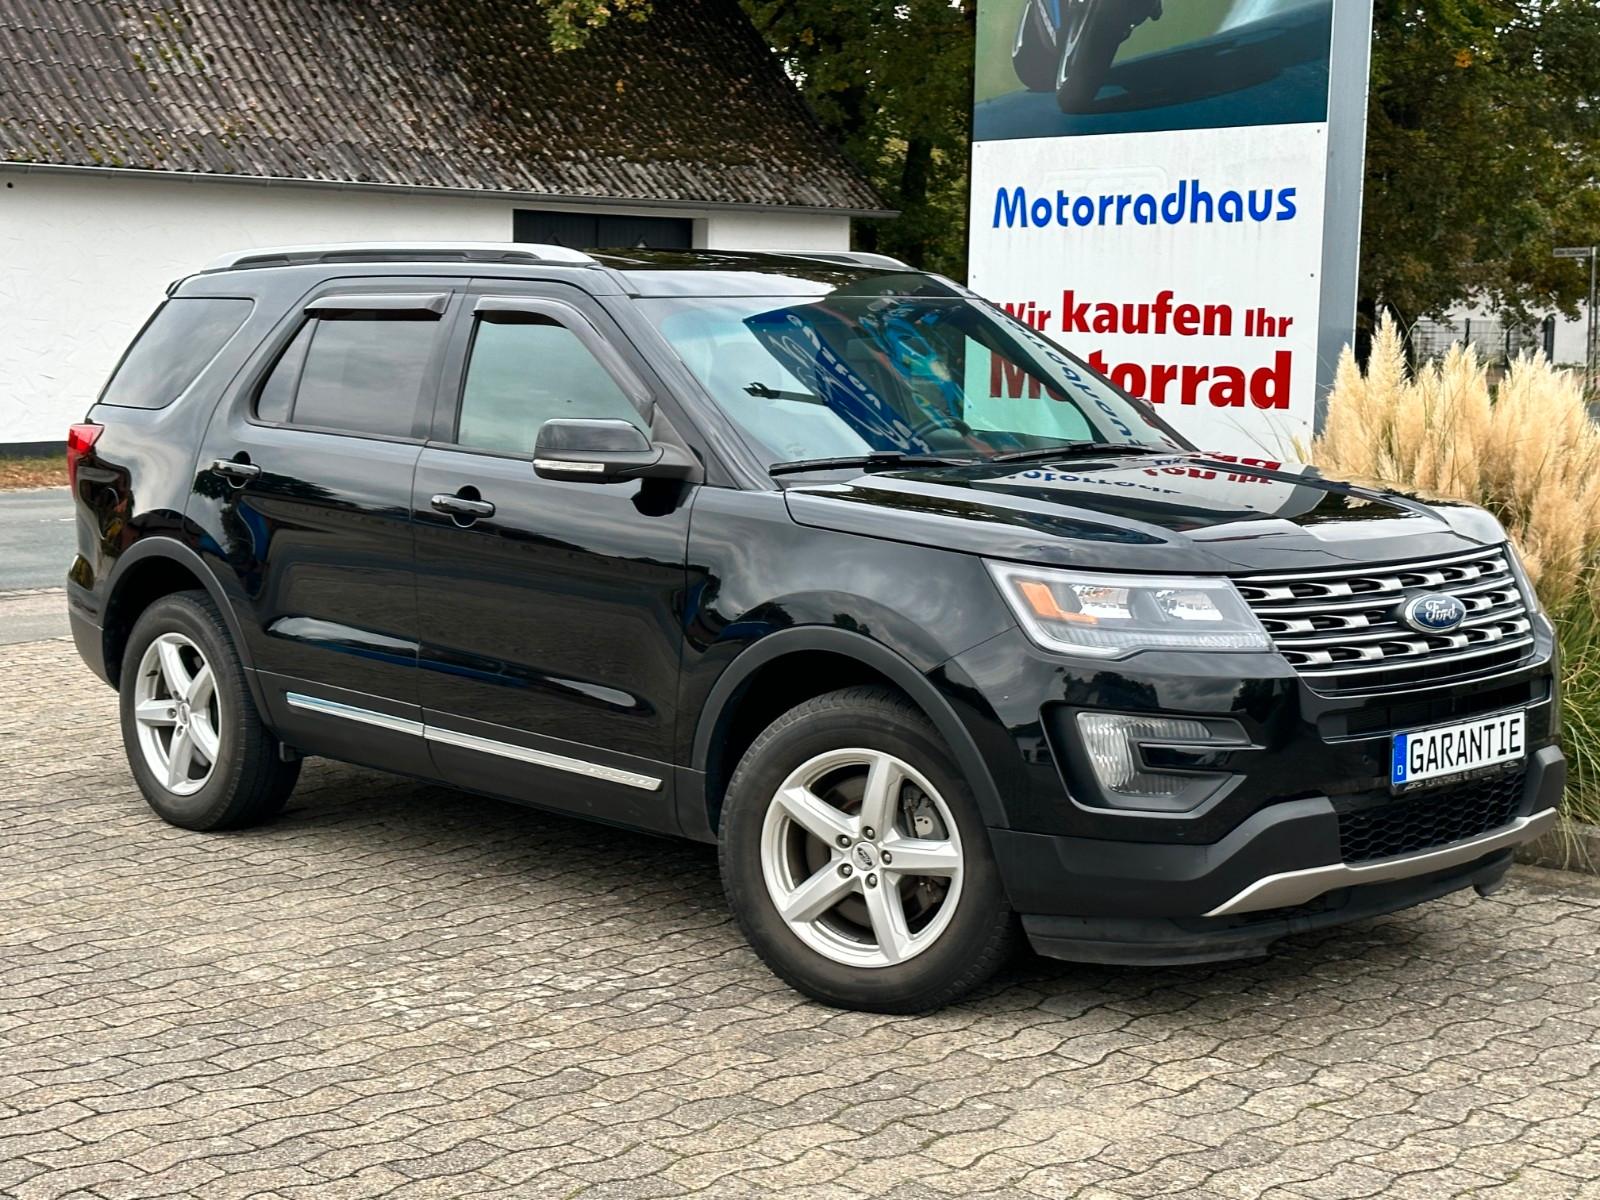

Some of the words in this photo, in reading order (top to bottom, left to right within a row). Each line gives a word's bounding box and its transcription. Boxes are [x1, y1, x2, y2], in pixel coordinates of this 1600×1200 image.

[992, 179, 1297, 229] Motorradhaus
[1061, 290, 1232, 336] kaufen
[1244, 308, 1293, 338] Ihr
[988, 350, 1293, 410] Morrad
[1425, 600, 1458, 622] Ford
[1397, 764, 1404, 776] D
[1410, 718, 1521, 774] GARANTIE
